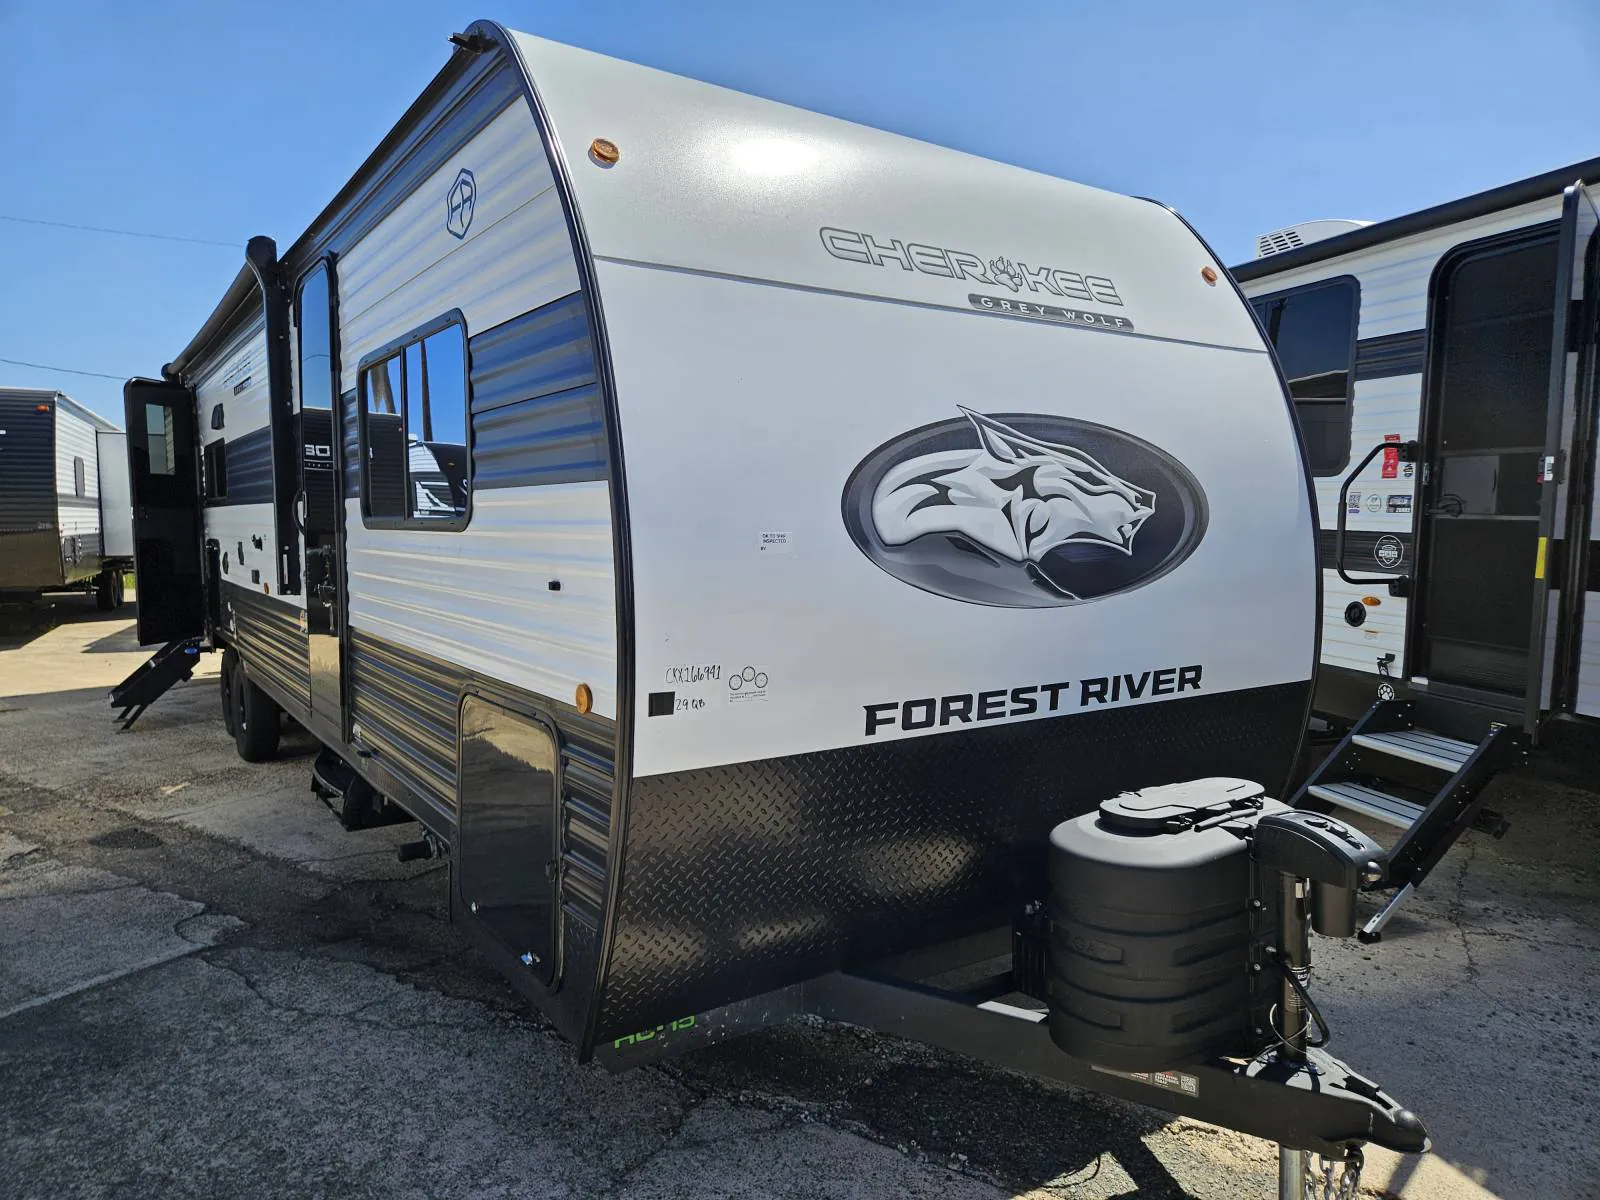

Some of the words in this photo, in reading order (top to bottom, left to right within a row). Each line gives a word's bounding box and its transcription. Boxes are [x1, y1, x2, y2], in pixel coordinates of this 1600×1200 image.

[980, 296, 1048, 316] GREY
[1062, 309, 1126, 328] WOLF
[863, 681, 1070, 736] FOREST
[1079, 664, 1203, 706] RIVER
